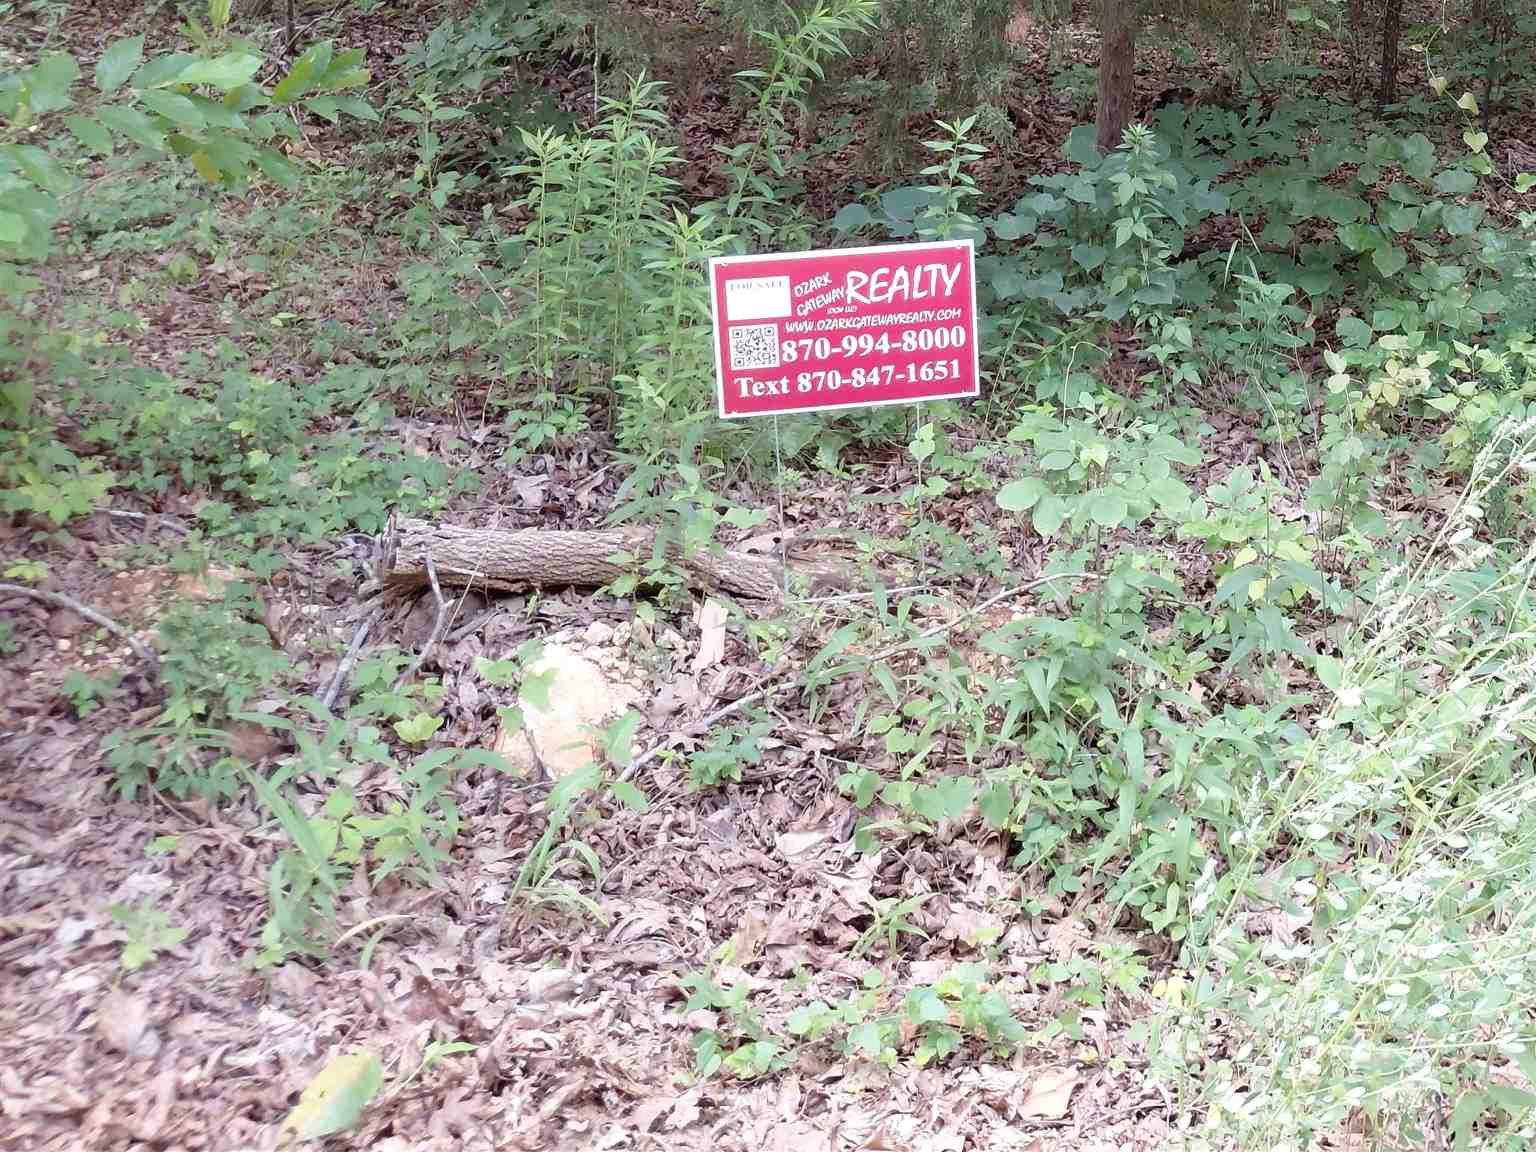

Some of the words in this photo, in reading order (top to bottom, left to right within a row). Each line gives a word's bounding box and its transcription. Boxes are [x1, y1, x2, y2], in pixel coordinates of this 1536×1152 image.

[794, 272, 832, 297] OZARK
[845, 262, 961, 305] REALTY
[796, 286, 845, 316] GATEWAY
[785, 308, 961, 333] WWW.OZARKGATEWAYREALTY.COM
[782, 326, 966, 361] 870-994-8000
[734, 375, 790, 397] Text
[797, 359, 961, 392] 870-847-1651
